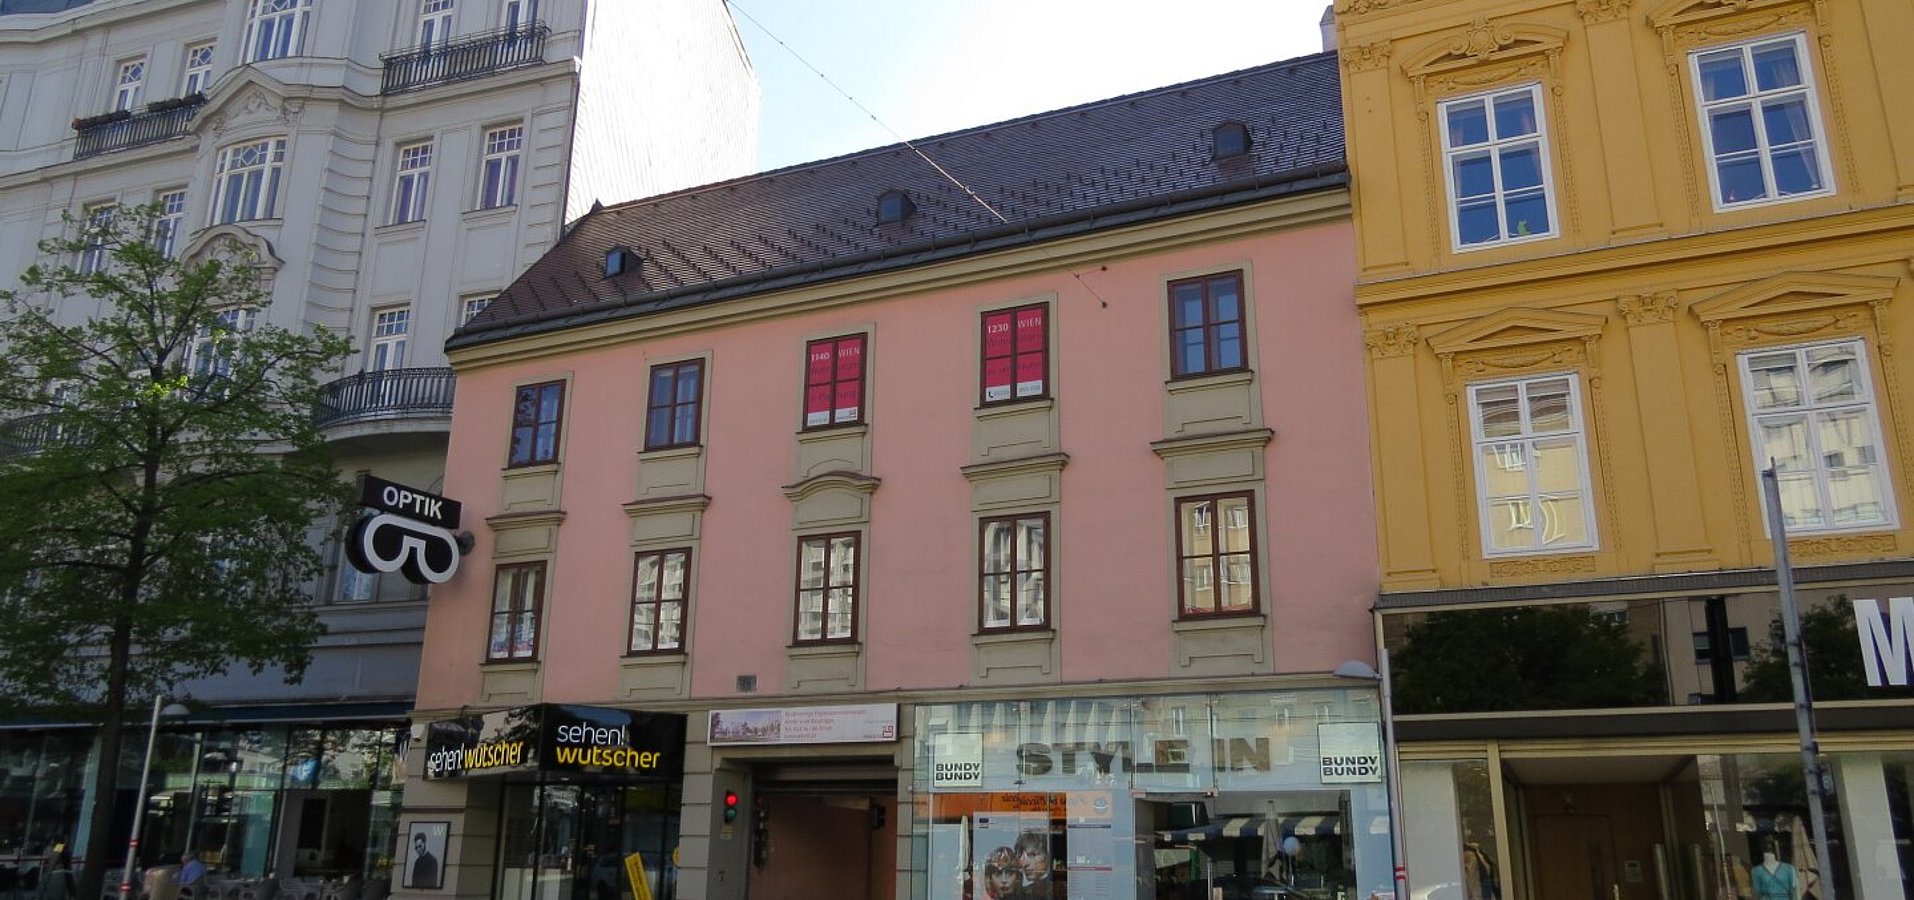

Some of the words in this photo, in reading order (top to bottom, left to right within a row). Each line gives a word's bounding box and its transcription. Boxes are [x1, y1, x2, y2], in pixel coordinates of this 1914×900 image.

[987, 323, 1009, 334] 1230
[1017, 317, 1042, 329] WIEN
[838, 346, 860, 359] WIEN
[383, 486, 442, 519] OPTIK
[557, 722, 626, 746] sehen!
[429, 743, 464, 772] sehen!
[464, 741, 524, 769] wutscher
[556, 746, 661, 769] wutscher
[1016, 740, 1190, 776] STYLE
[1215, 737, 1271, 772] IN
[1322, 756, 1378, 766] BUNDY
[936, 763, 981, 772] BUNDY
[1323, 766, 1379, 776] BUNDY
[936, 772, 981, 781] BUNDY
